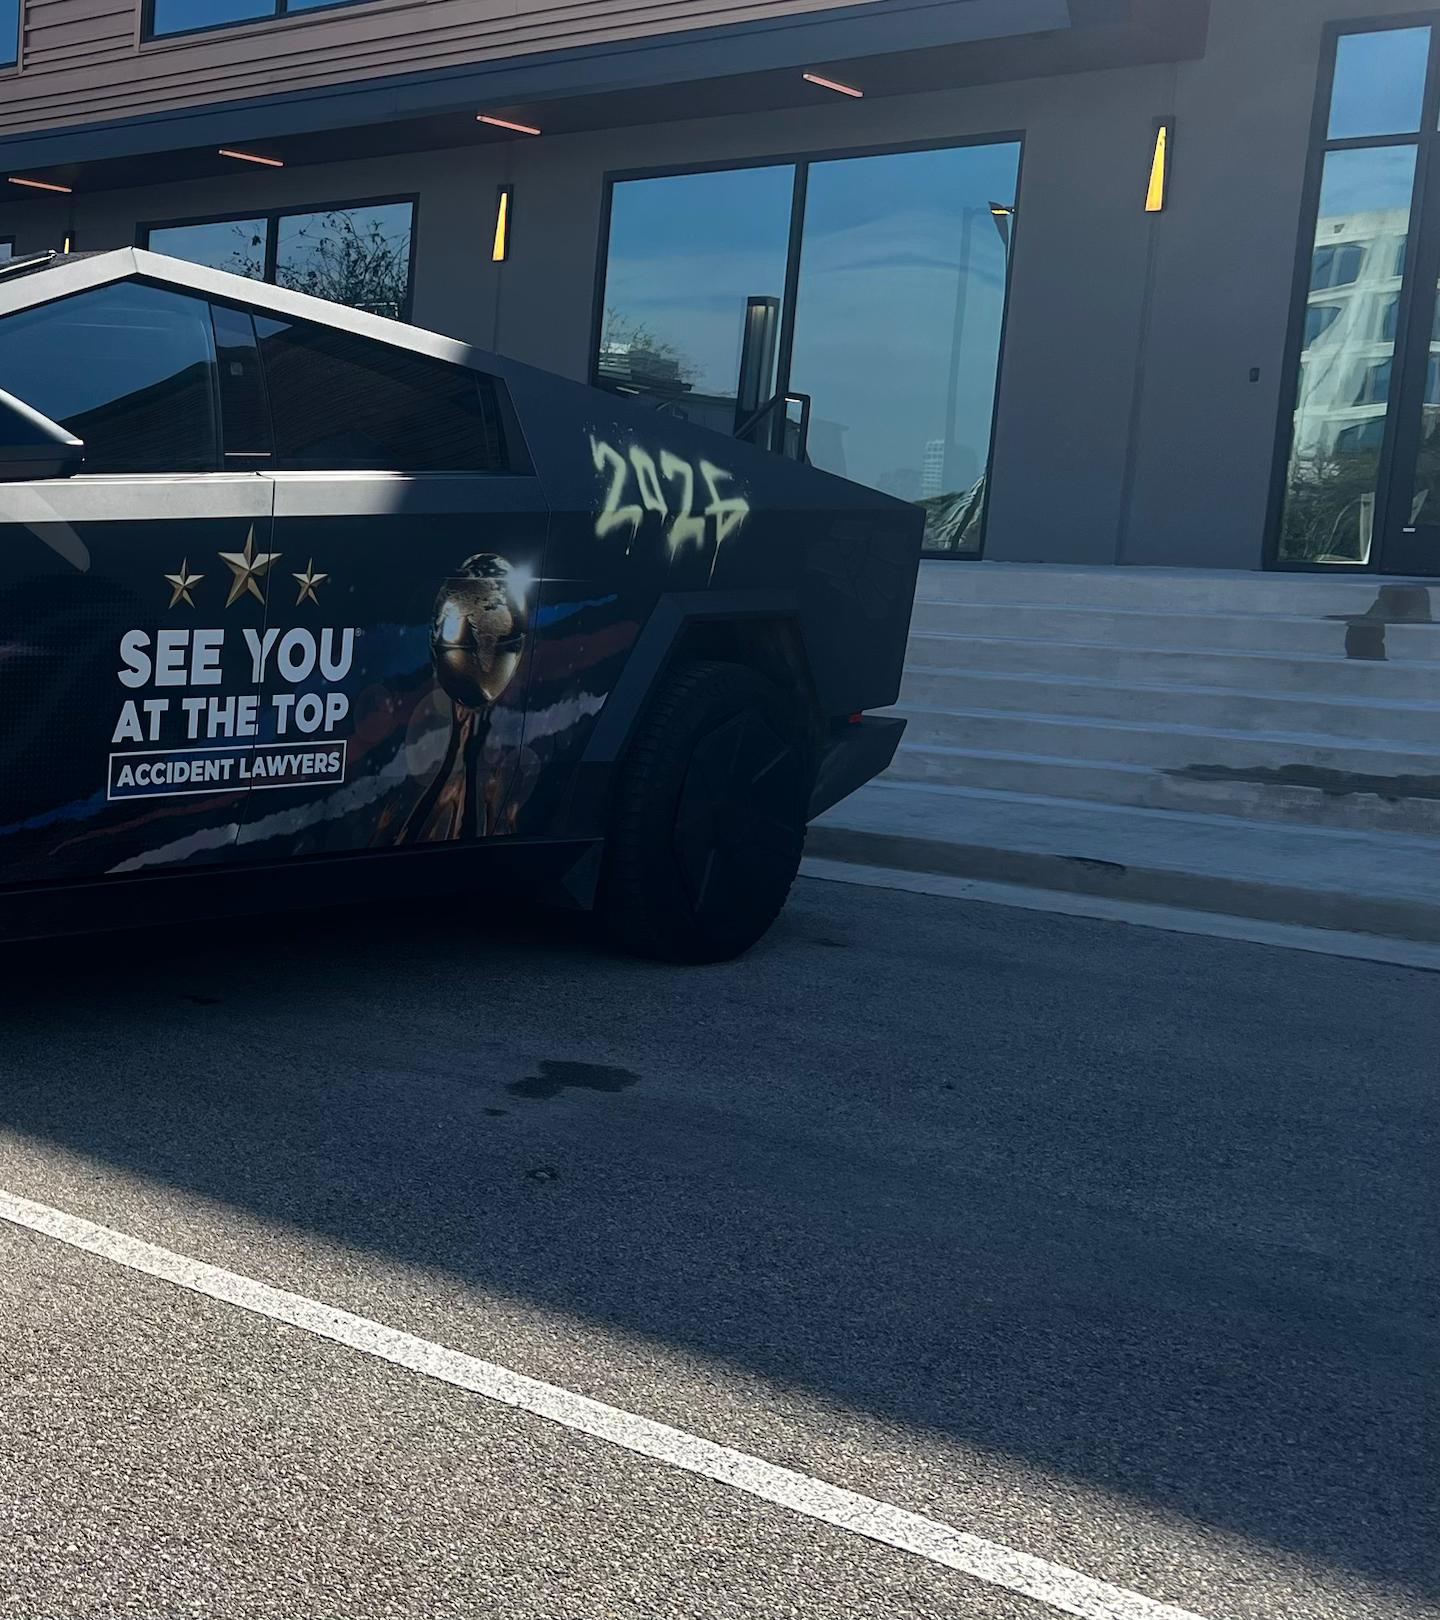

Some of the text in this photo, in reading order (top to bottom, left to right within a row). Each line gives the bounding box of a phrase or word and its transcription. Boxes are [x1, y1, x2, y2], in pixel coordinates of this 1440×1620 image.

[117, 627, 355, 688] SEE YOU
[111, 692, 350, 743] AT THE TOP
[116, 751, 341, 787] ACCIDENT LAWYERS
